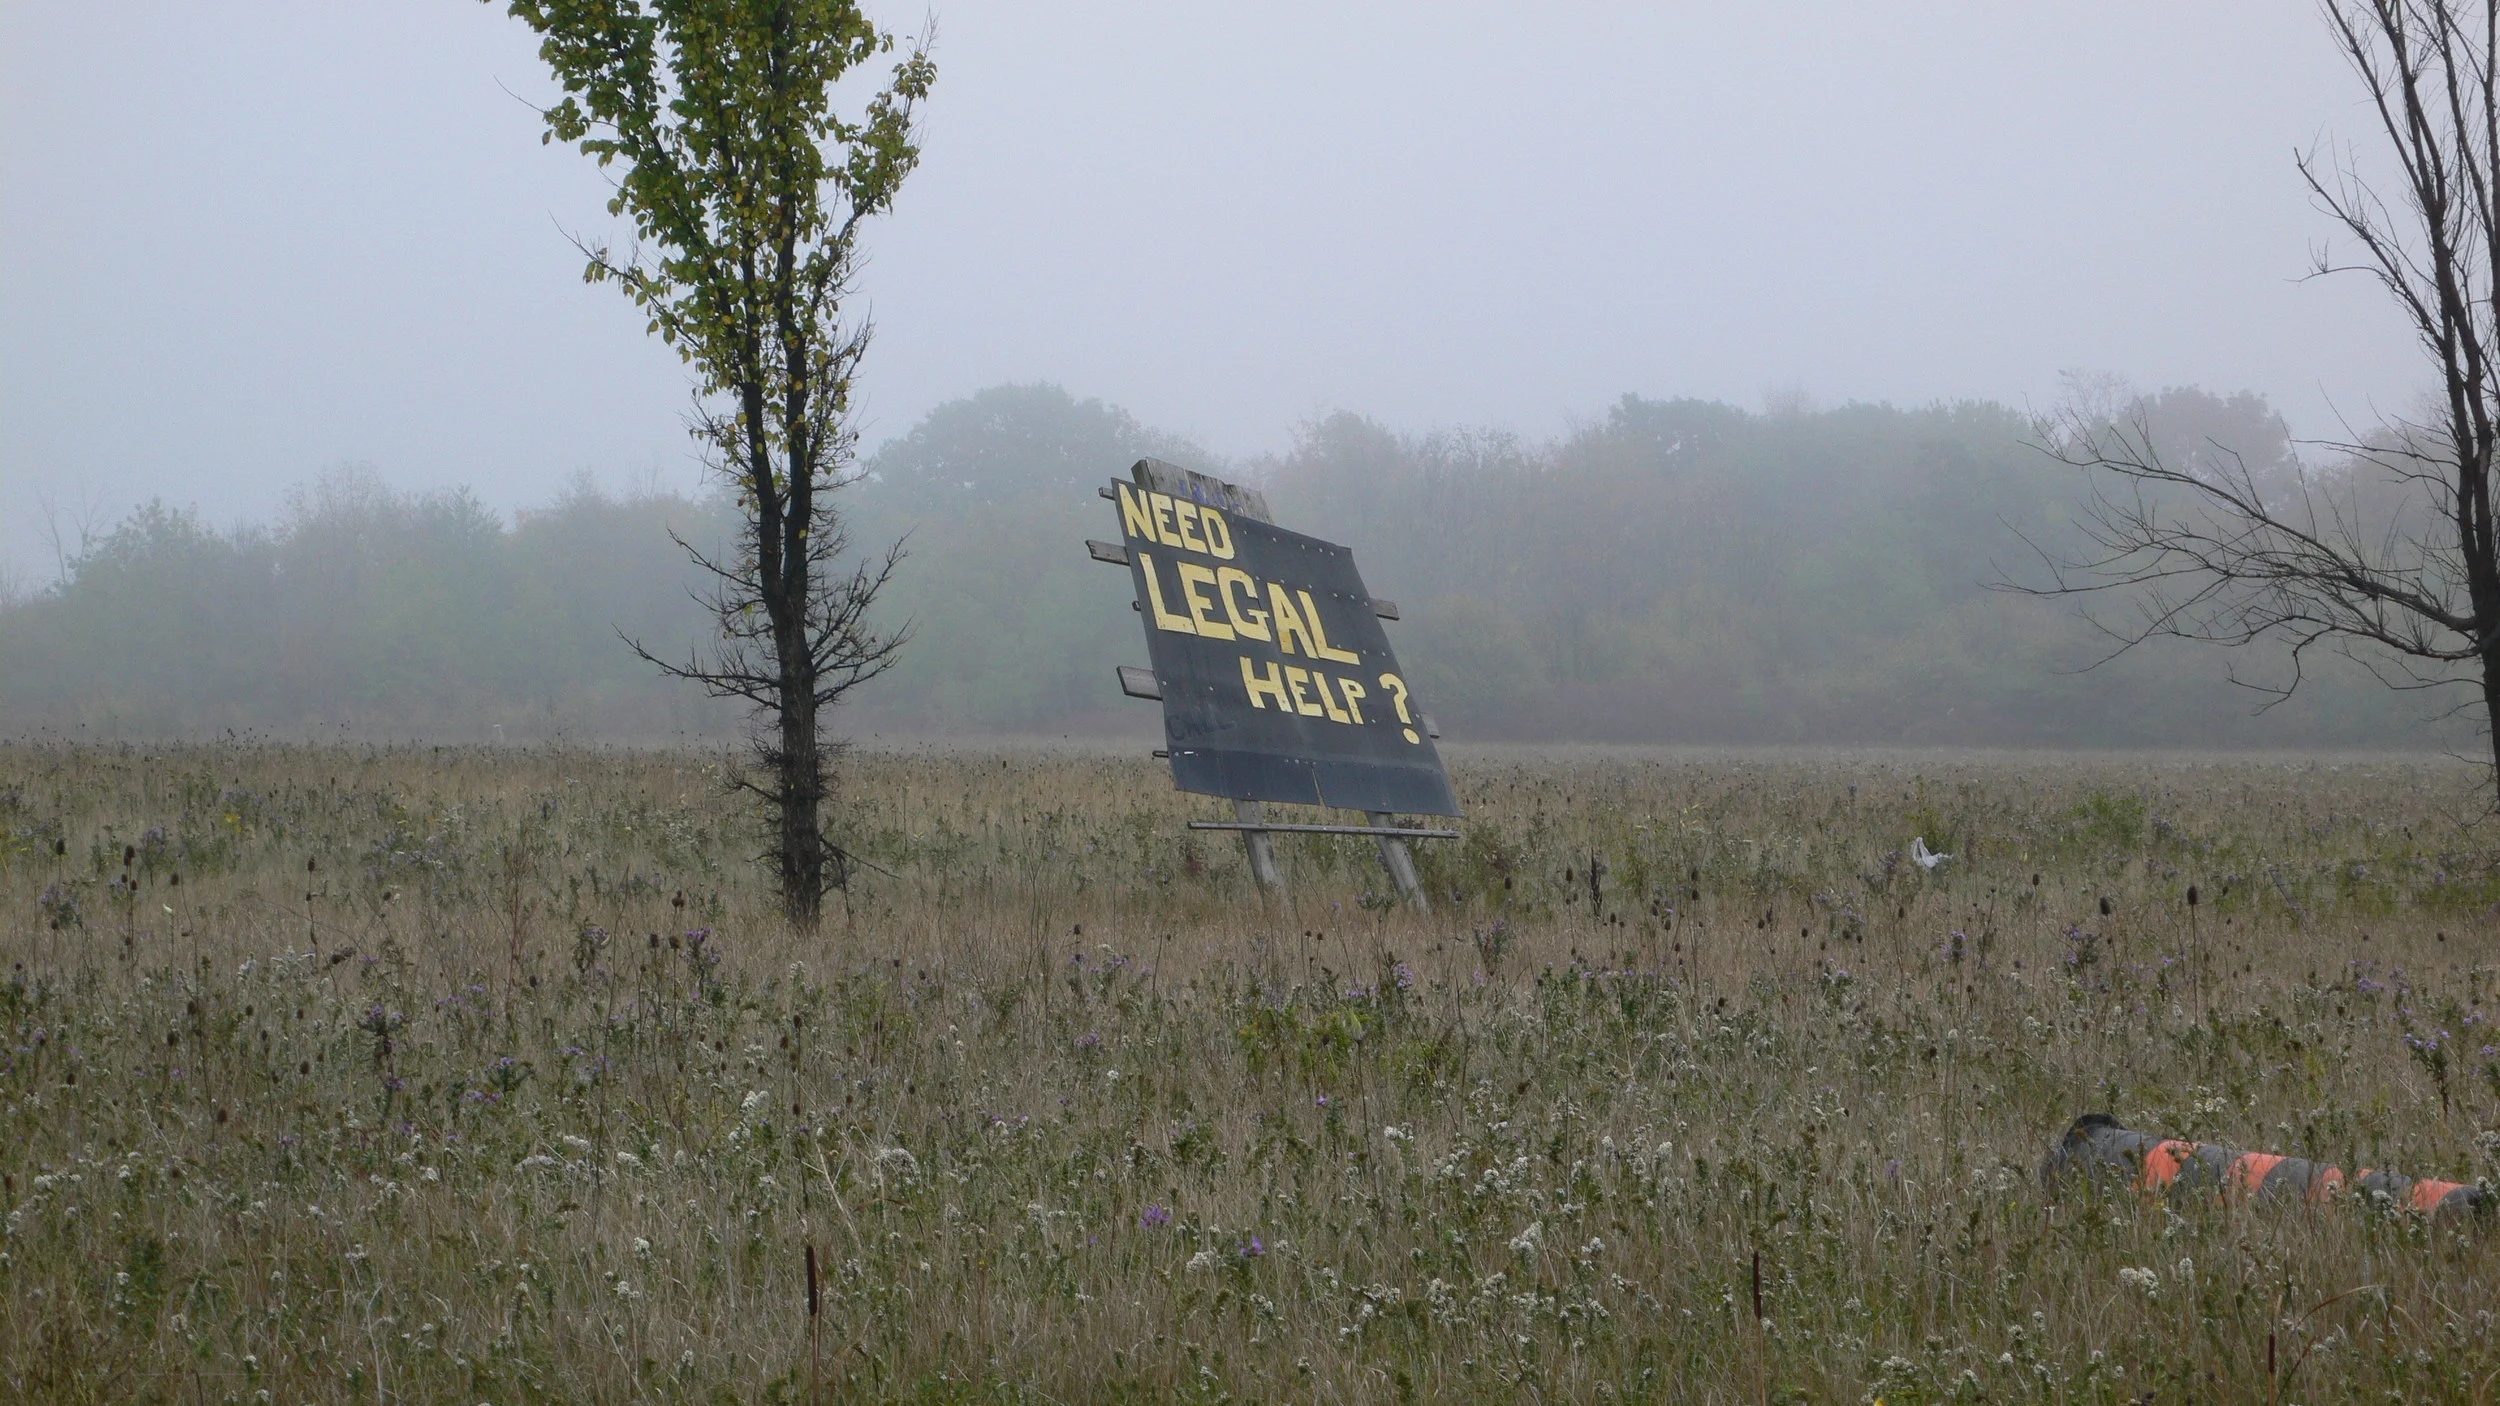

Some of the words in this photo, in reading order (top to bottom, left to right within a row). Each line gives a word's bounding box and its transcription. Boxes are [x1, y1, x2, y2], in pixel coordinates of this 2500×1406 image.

[1118, 483, 1235, 560] NEED
[1138, 553, 1360, 666] LEGAL
[1239, 656, 1366, 724] HELP
[1378, 673, 1420, 745] ?
